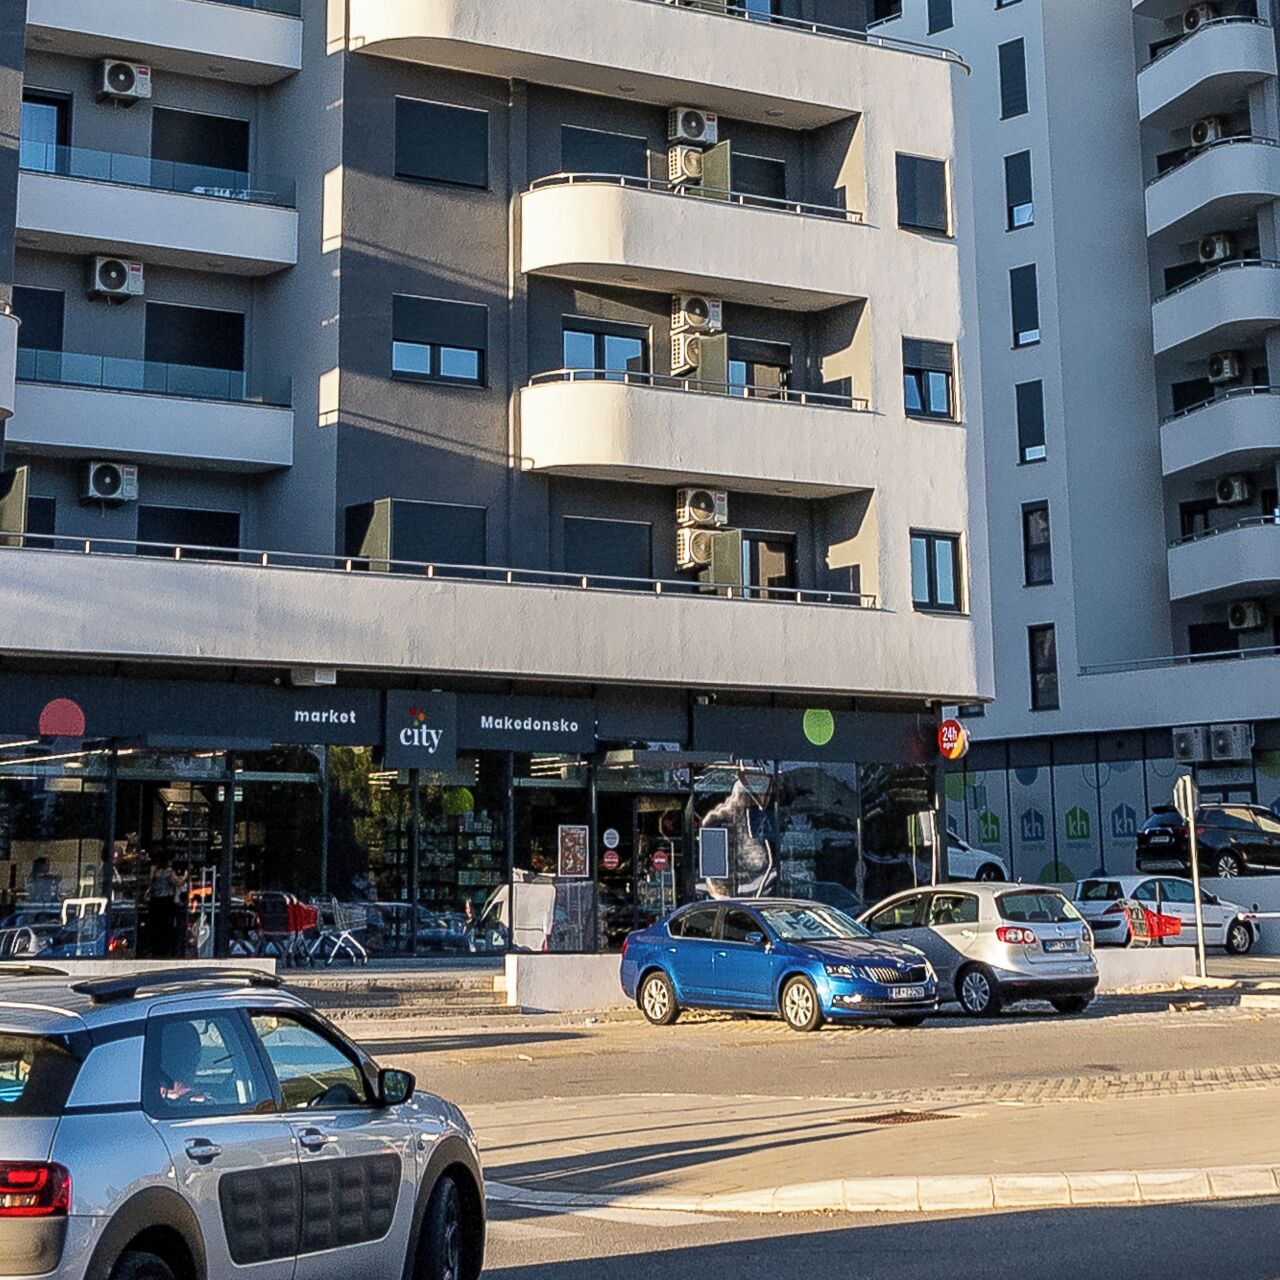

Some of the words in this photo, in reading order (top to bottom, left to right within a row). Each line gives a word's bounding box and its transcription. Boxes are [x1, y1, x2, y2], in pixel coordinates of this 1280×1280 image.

[294, 709, 357, 724] market
[480, 715, 580, 733] Makedonsko
[399, 722, 444, 754] city
[942, 726, 958, 741] 24h
[1024, 809, 1042, 839] kh
[1070, 807, 1088, 837] kh
[1114, 804, 1133, 834] kh
